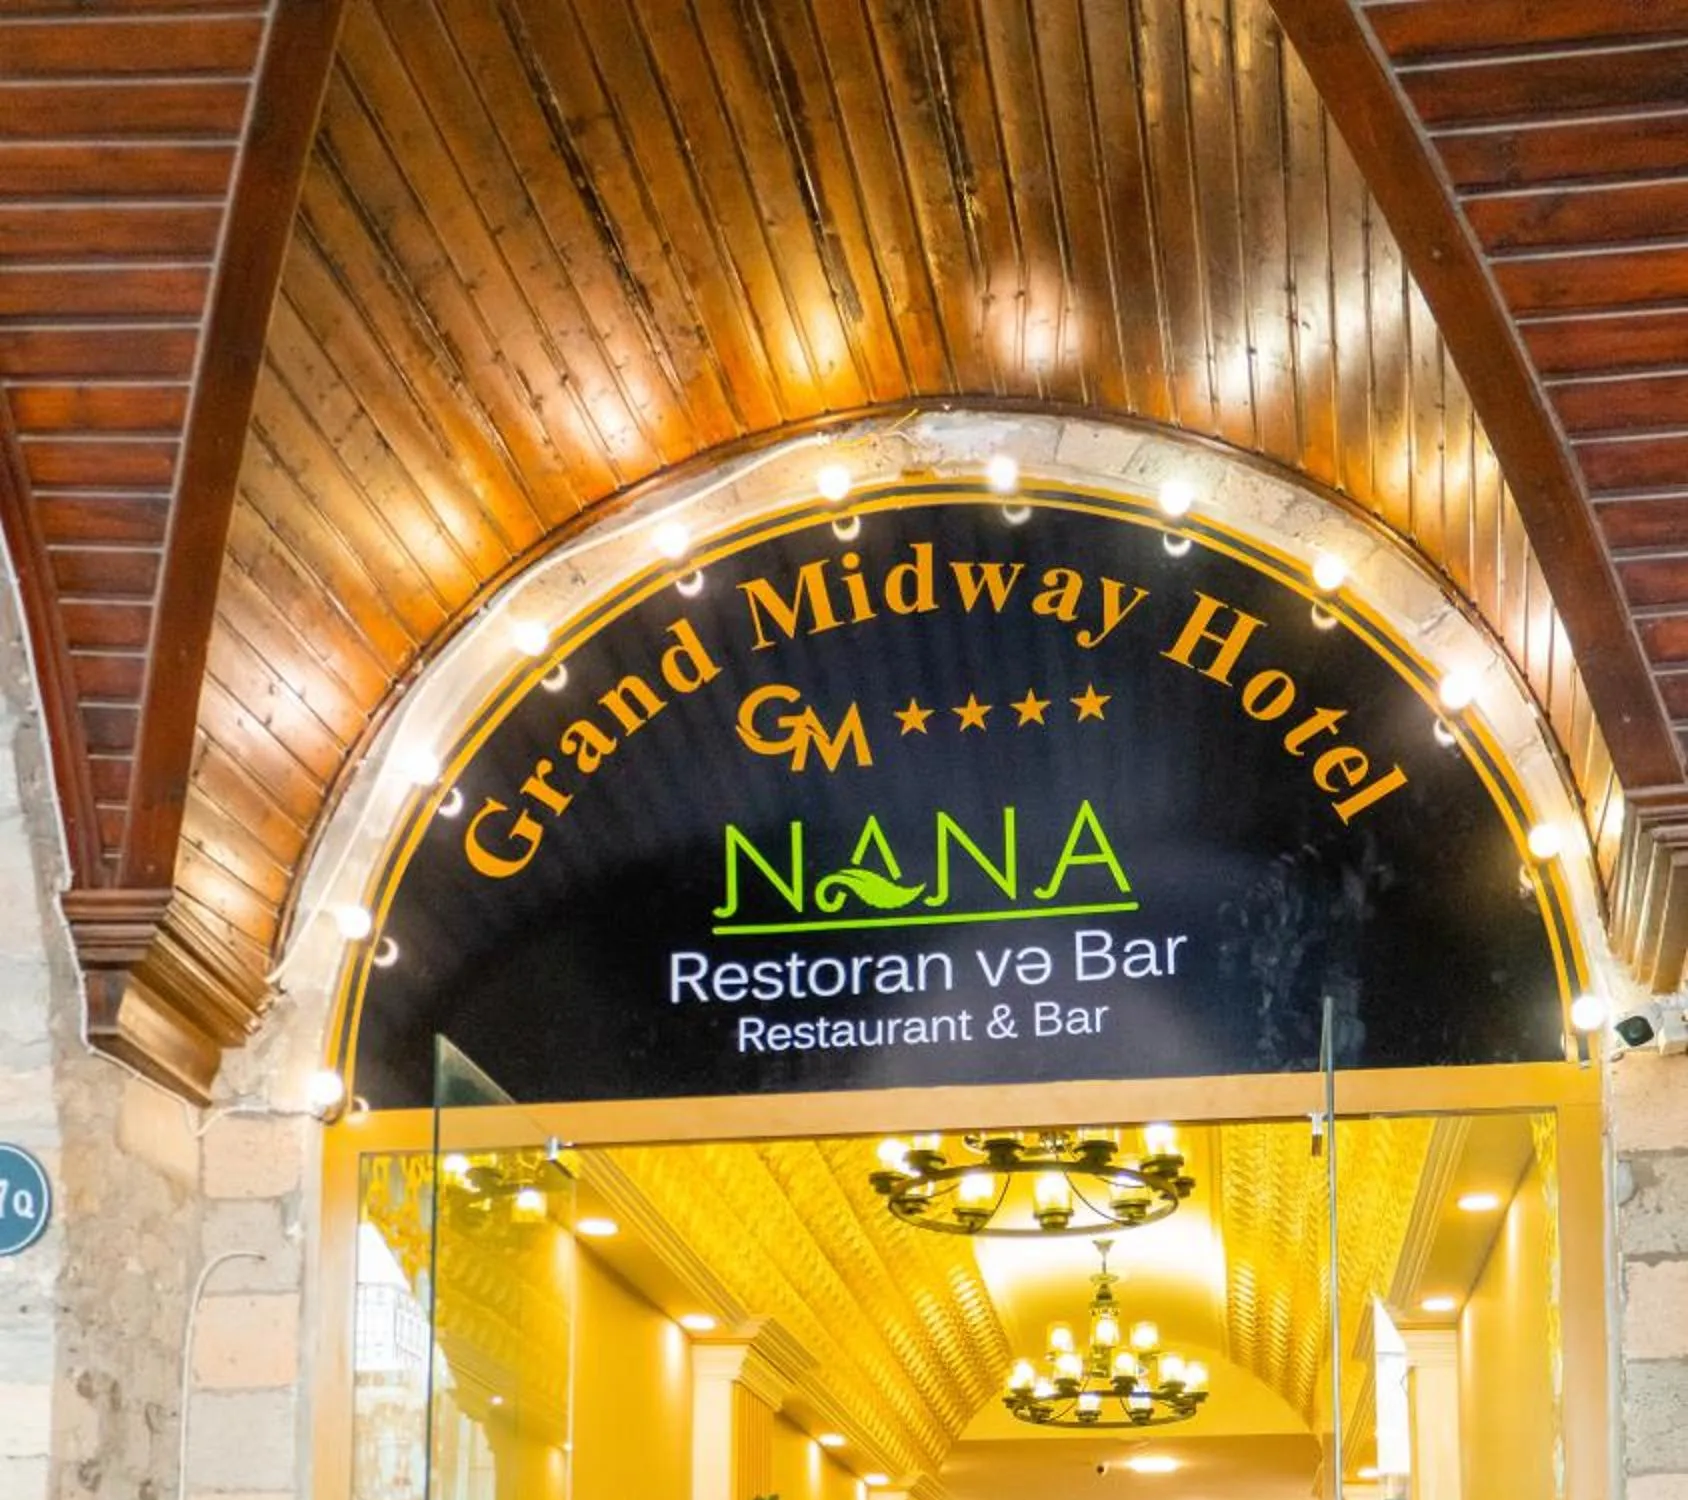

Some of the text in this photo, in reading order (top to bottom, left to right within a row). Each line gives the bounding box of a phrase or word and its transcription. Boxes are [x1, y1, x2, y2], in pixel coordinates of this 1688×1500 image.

[463, 541, 1409, 880] Grand Midway Hotel
[736, 683, 873, 772] GM
[712, 799, 1133, 919] NANA
[670, 928, 1189, 1005] Restoran və Bar
[737, 1000, 1111, 1053] Restaurant & Bar
